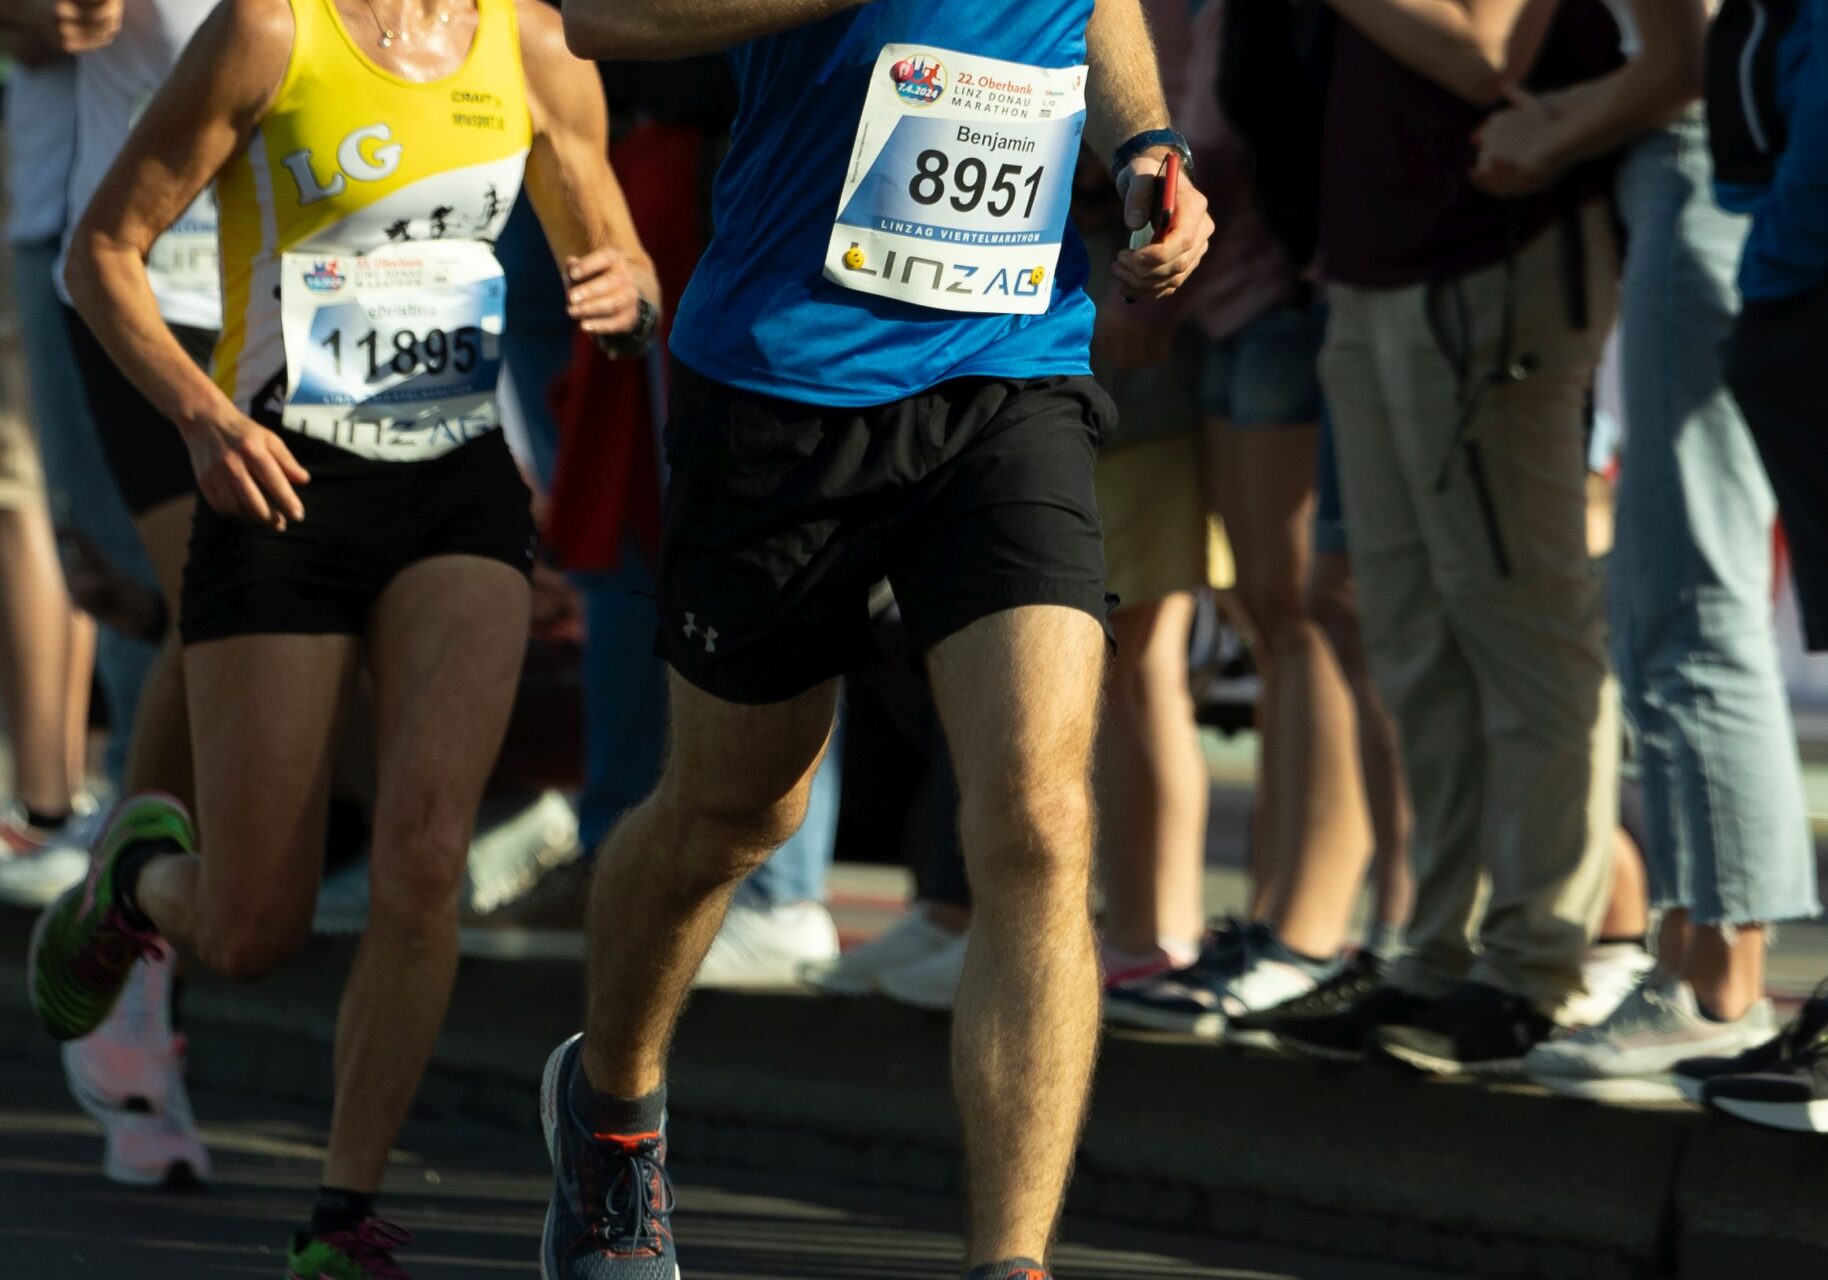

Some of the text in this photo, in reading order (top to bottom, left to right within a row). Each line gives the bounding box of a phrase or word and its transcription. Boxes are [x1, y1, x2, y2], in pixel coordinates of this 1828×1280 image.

[898, 83, 939, 99] 7.4.2024
[957, 72, 1033, 96] 22. Oberbank
[951, 97, 1028, 118] MARATHON
[954, 86, 982, 100] LINZ
[988, 92, 1031, 107] DONAU
[956, 125, 1036, 153] Benjamin
[908, 149, 1045, 219] 8951
[940, 230, 1041, 244] VIERTELMARATHON
[320, 325, 478, 378] 11895
